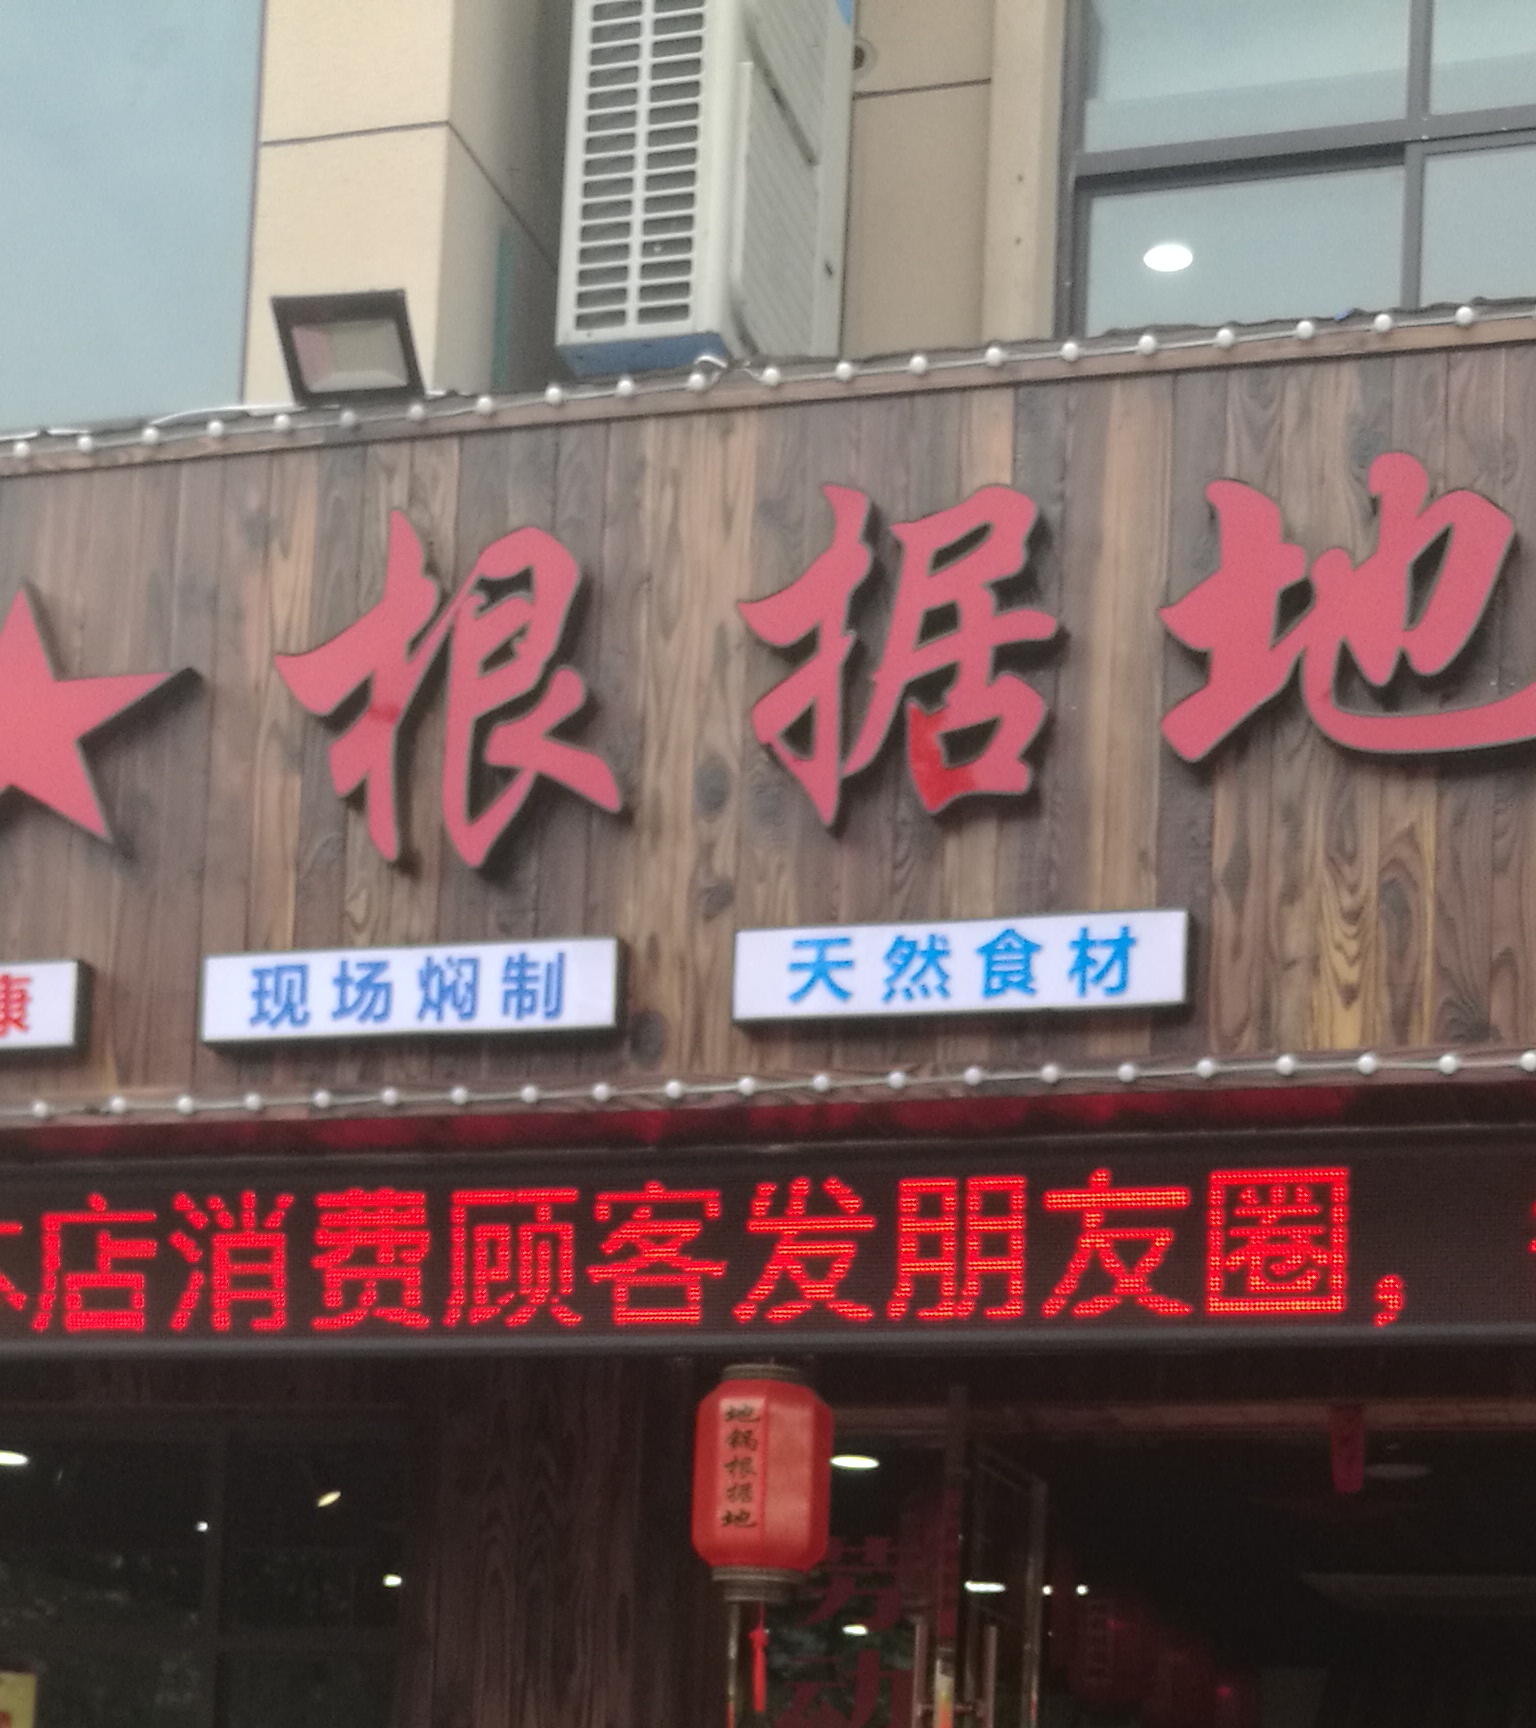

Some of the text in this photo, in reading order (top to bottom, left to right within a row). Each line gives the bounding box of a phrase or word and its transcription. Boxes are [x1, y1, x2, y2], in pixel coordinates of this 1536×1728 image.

[247, 950, 568, 1030] 现场焖制
[786, 925, 1140, 1004] 天然食材
